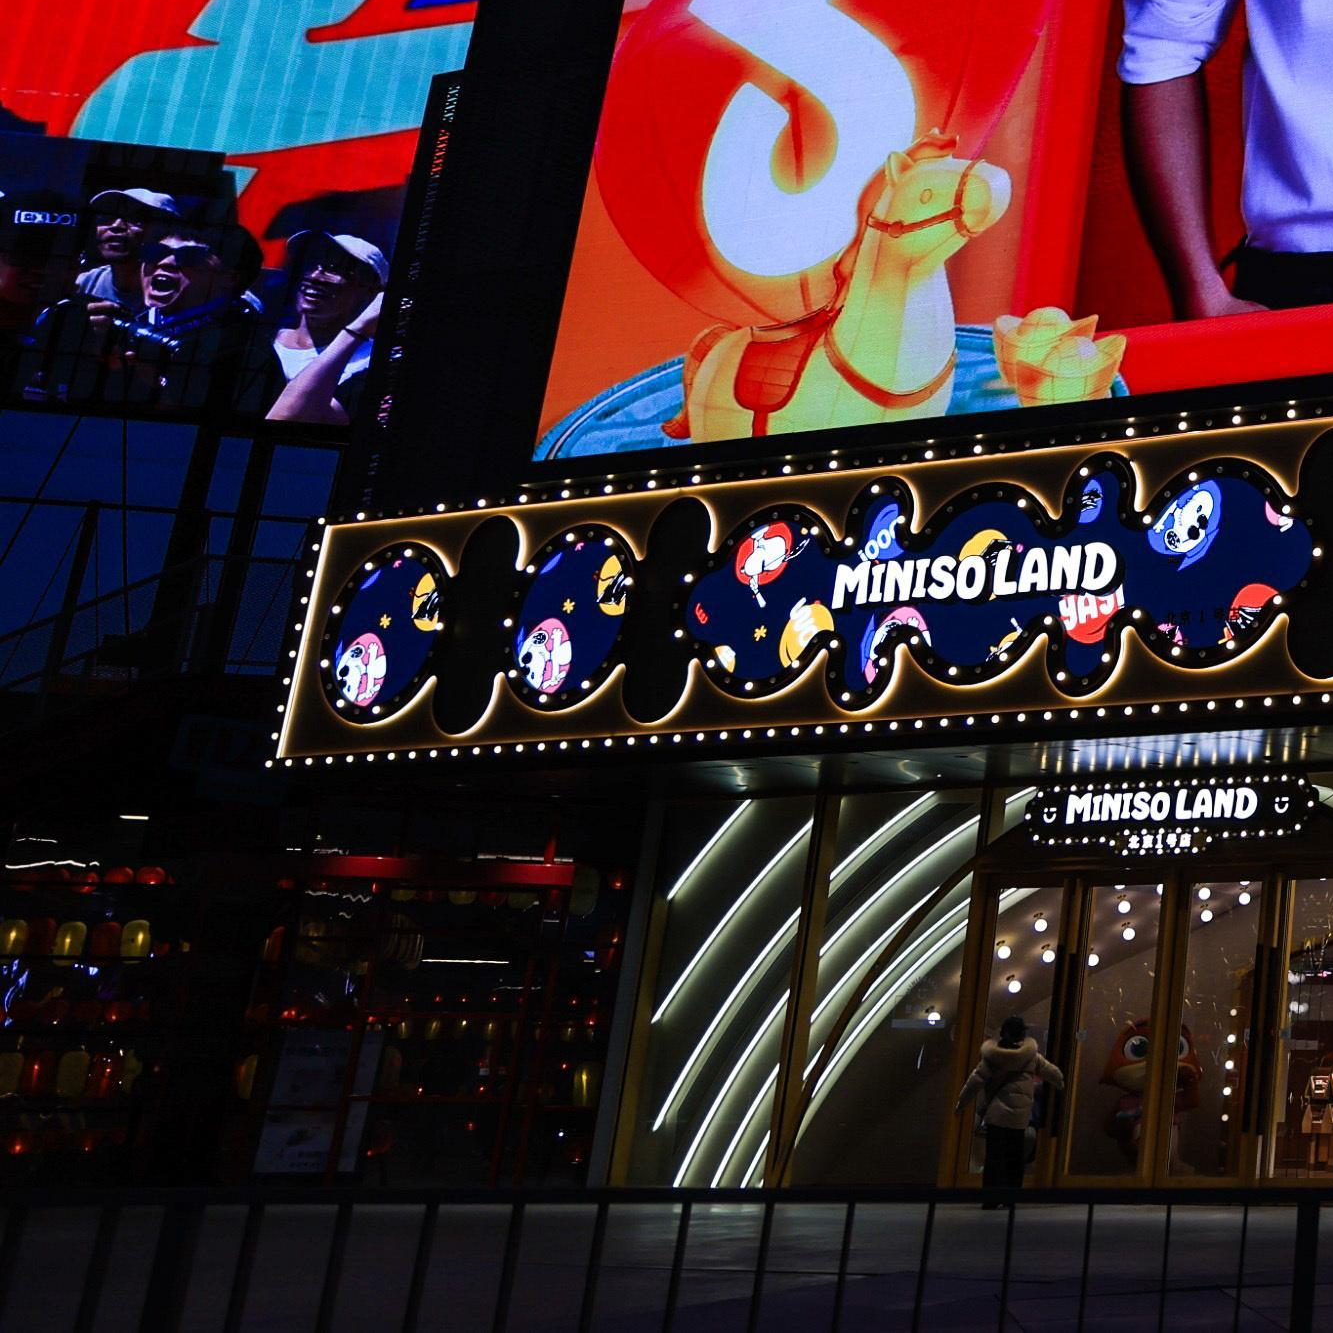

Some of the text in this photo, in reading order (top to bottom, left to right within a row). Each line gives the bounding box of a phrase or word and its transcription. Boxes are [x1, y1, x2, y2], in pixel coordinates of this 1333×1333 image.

[831, 541, 1119, 611] MINISO LAND
[1065, 787, 1259, 826] MINISO LAND
